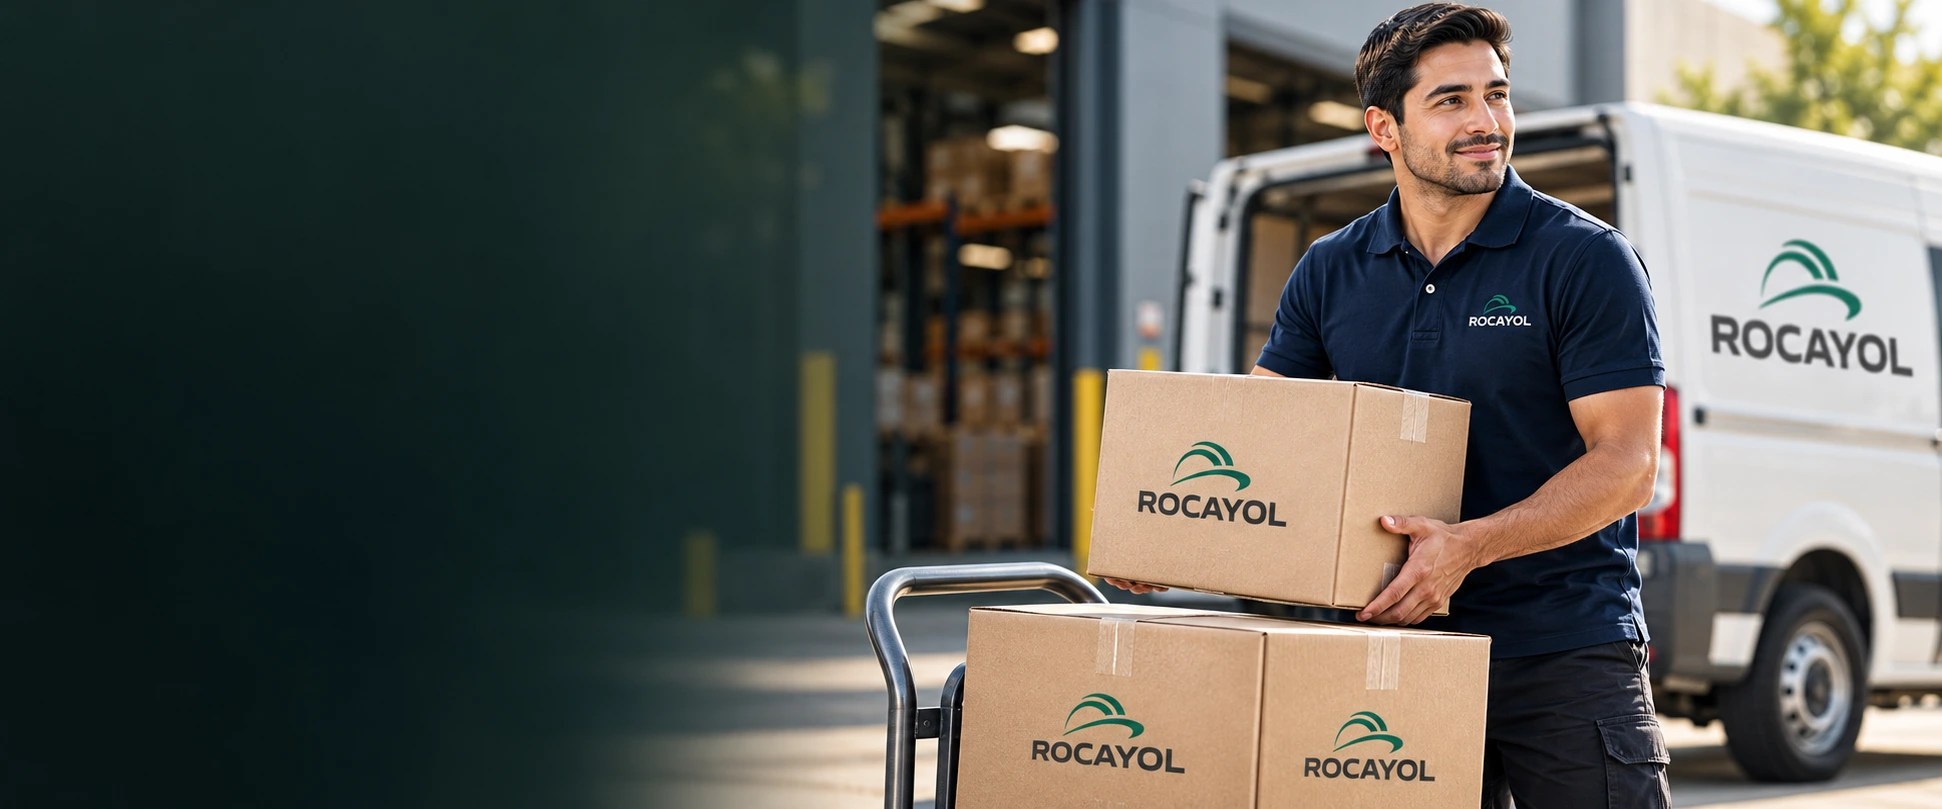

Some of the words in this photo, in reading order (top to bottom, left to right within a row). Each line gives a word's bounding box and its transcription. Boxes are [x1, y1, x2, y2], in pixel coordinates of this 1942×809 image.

[1468, 315, 1532, 327] ROCAYOL
[1711, 315, 1913, 377] ROCAYOL
[1137, 490, 1287, 528] ROCAYOL
[1031, 739, 1185, 774] ROCAYOL
[1304, 757, 1436, 782] ROCAYOL
